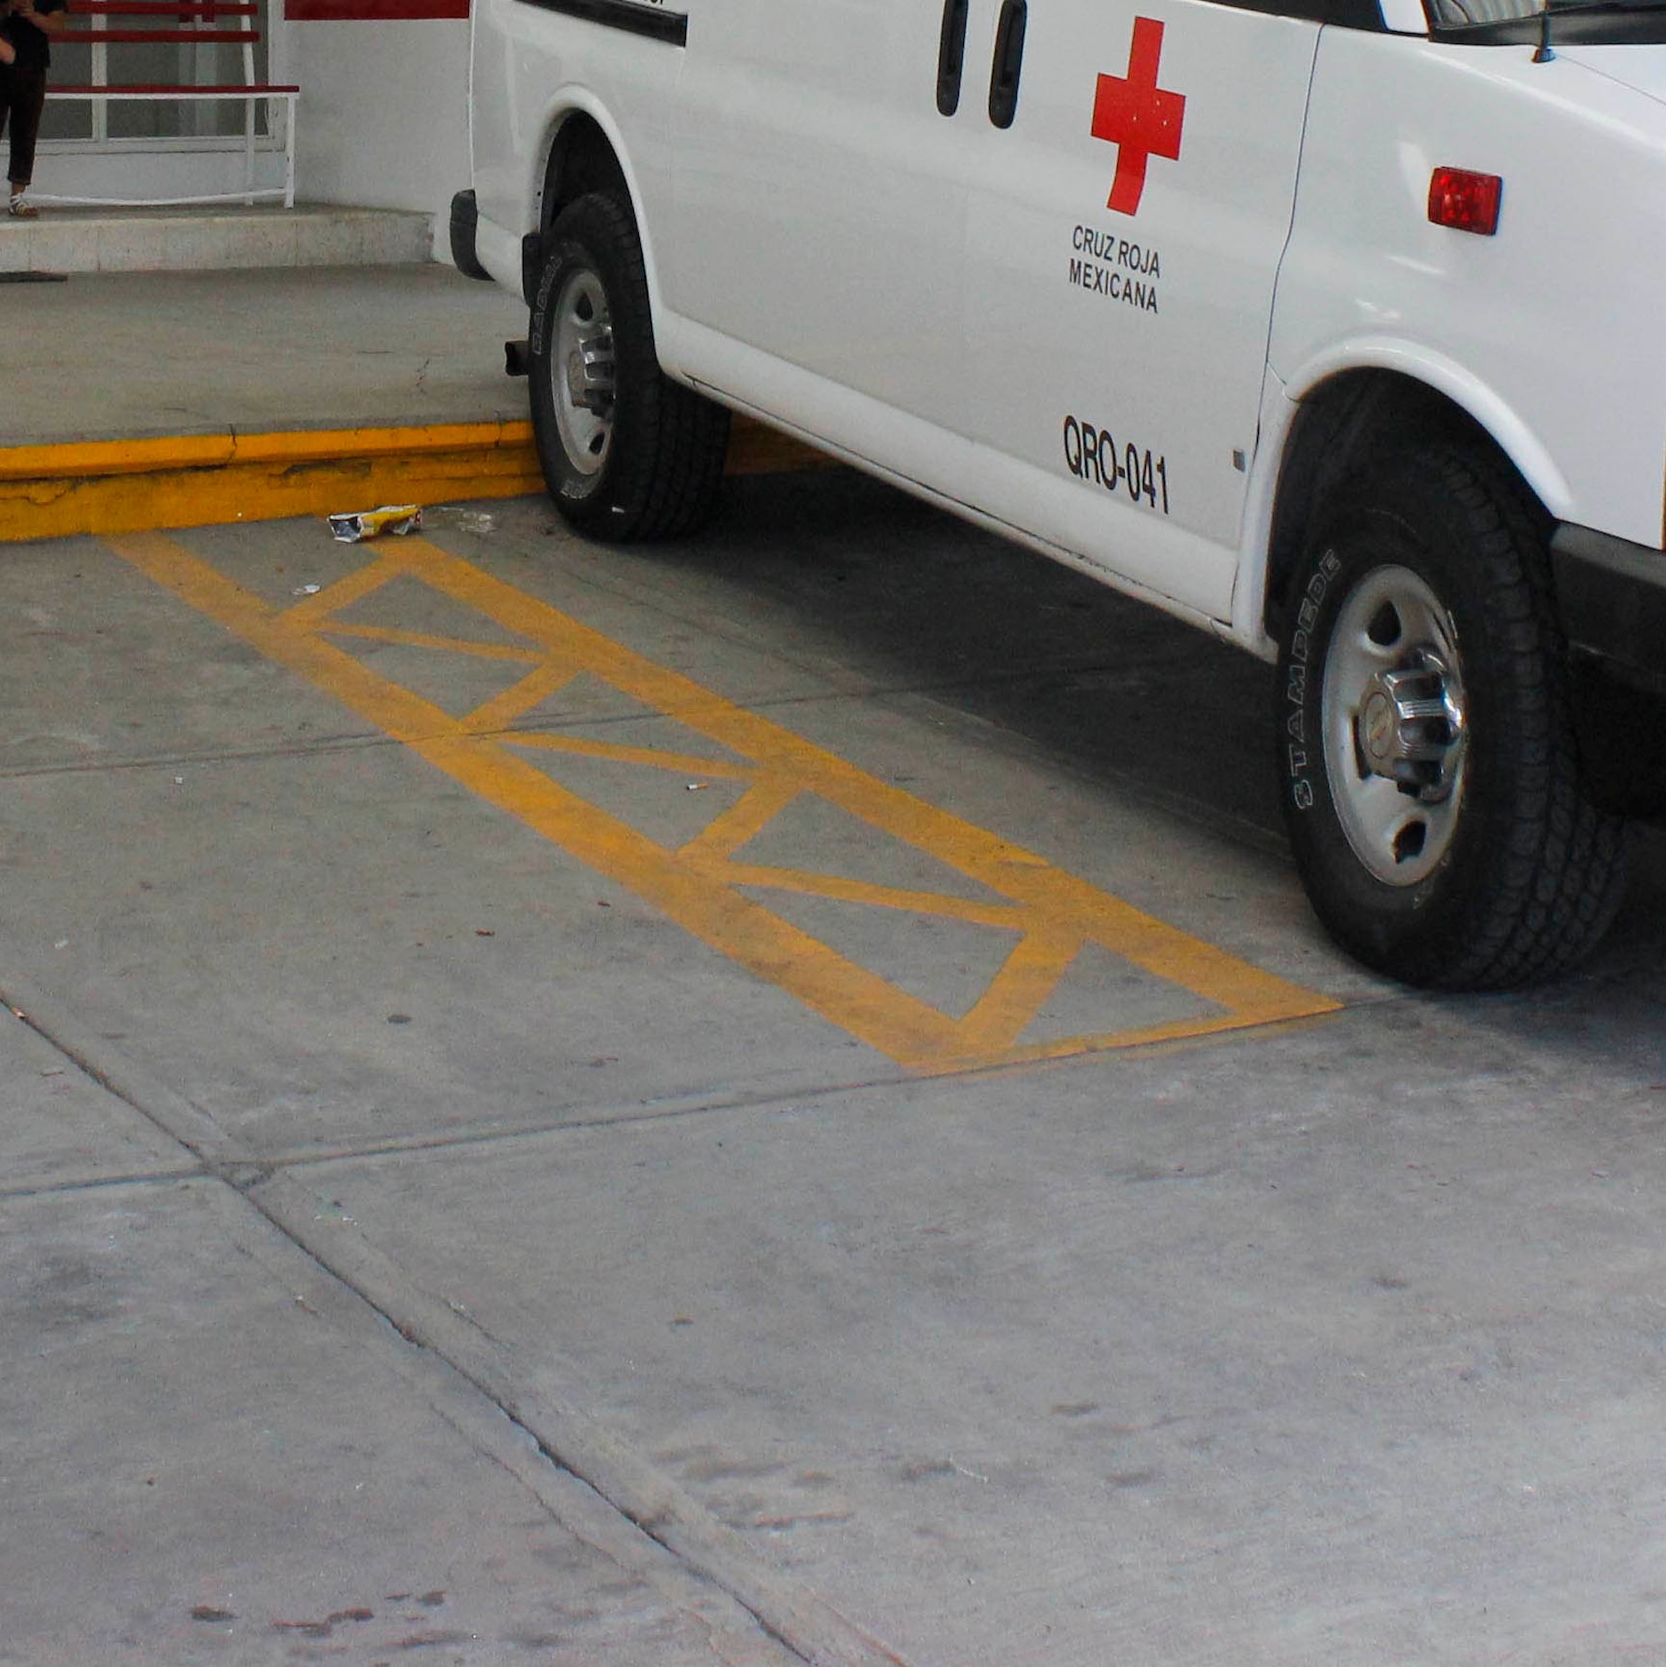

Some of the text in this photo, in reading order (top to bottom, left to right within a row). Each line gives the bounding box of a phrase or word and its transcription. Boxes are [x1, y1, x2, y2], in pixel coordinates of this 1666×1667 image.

[1073, 225, 1160, 279] CRUZ ROJA
[1069, 258, 1158, 314] MEXICANA
[1064, 414, 1169, 515] QRO-041
